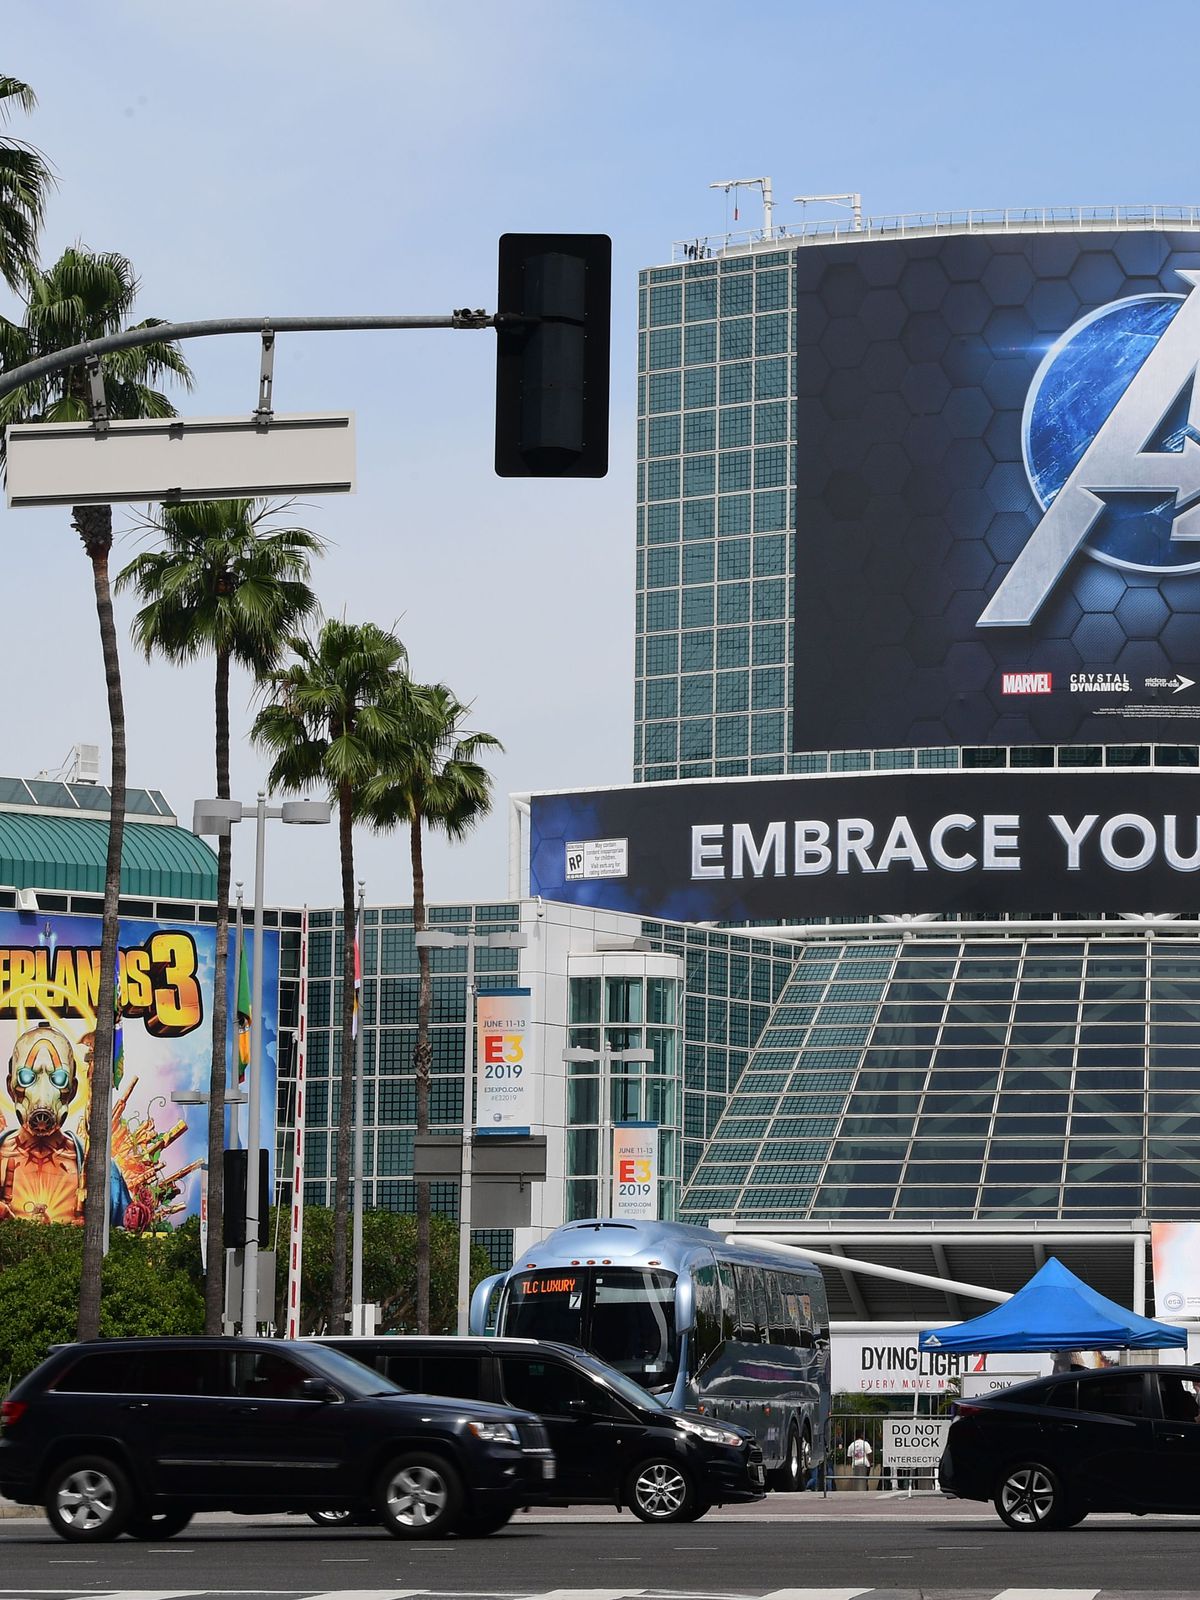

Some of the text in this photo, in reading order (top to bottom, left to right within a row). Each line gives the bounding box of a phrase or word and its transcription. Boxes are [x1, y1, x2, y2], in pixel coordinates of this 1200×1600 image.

[1002, 674, 1051, 694] MARVEL
[1070, 673, 1129, 683] CRYSTAL
[690, 813, 1021, 880] EMBRACE
[568, 854, 583, 871] RP
[150, 932, 202, 1030] 3
[483, 1019, 526, 1028] JUNE 11-13
[484, 1035, 524, 1063] E3
[484, 1064, 523, 1079] 2019
[619, 1160, 652, 1183] E3
[619, 1184, 651, 1196] 2019
[522, 1278, 576, 1294] TLC LUXURY
[571, 1295, 581, 1308] 7
[861, 1346, 918, 1371] DYING
[918, 1350, 968, 1376] LIGHT
[861, 1379, 896, 1389] EVERY
[902, 1379, 931, 1389] MOVE
[989, 1381, 1012, 1389] ONLY
[892, 1424, 942, 1435] DO NOT
[894, 1437, 940, 1448] BLOCK
